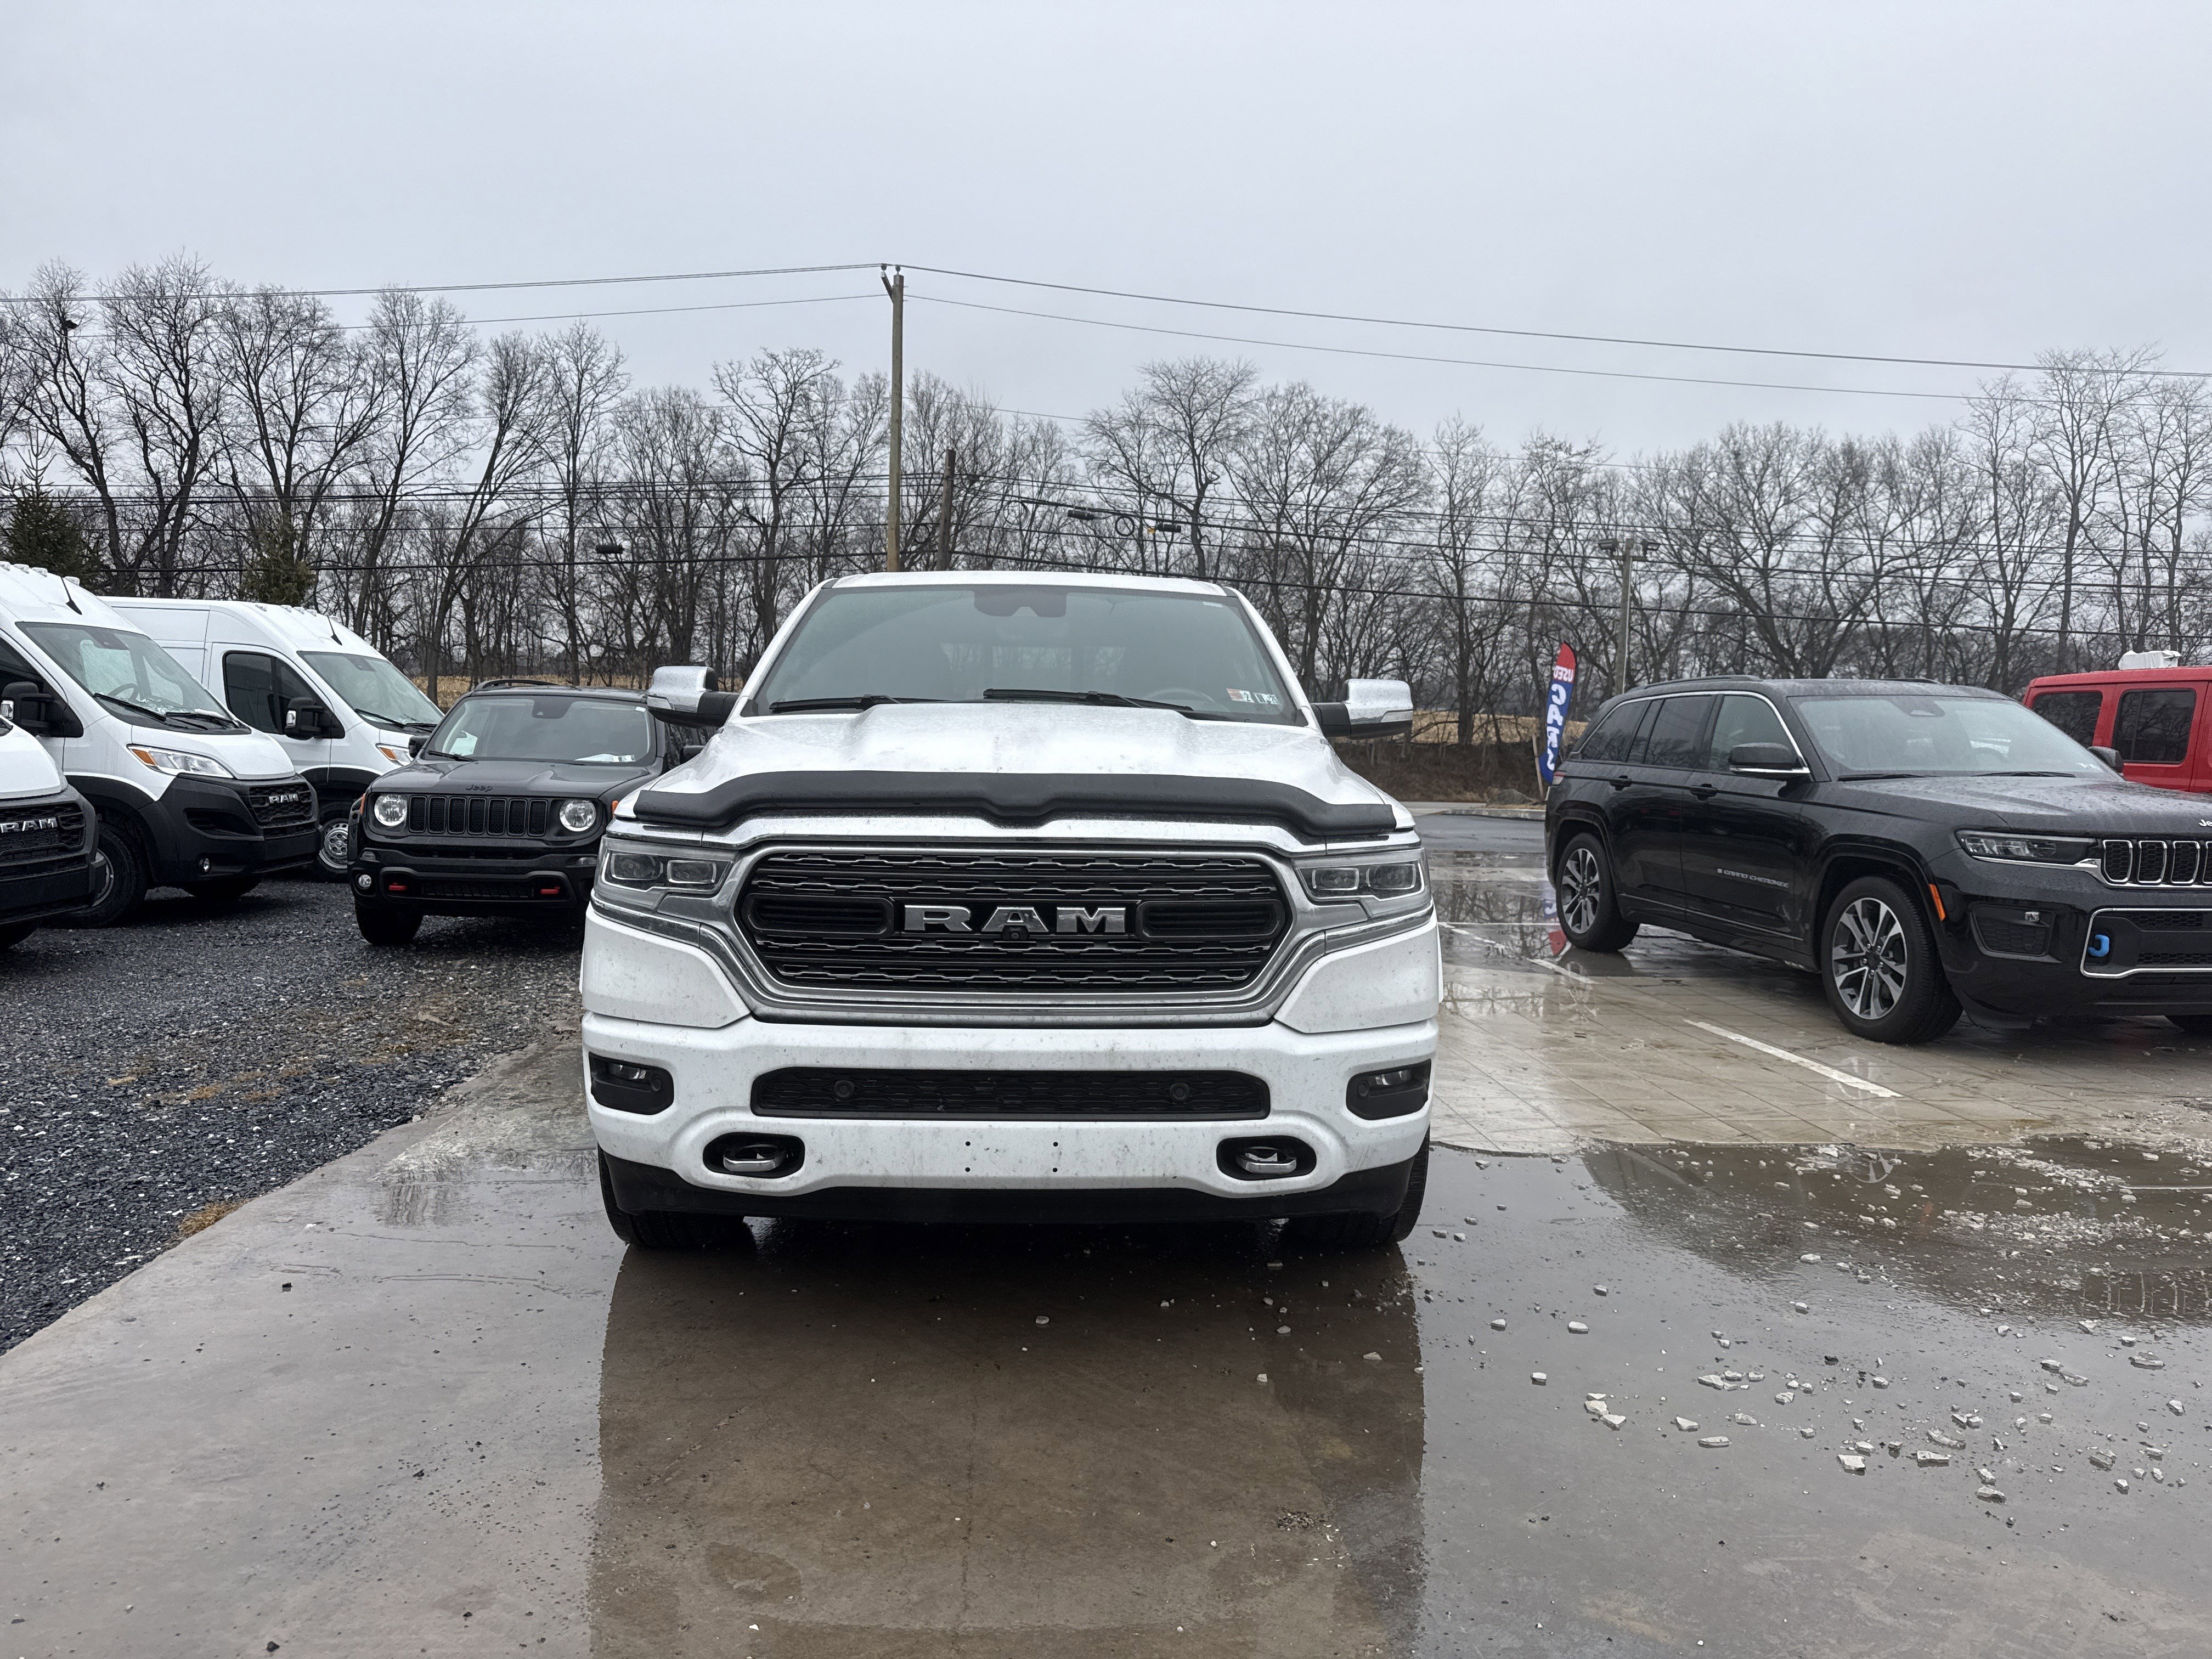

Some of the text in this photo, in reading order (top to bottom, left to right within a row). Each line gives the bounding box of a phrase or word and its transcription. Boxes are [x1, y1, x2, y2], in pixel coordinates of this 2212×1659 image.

[465, 783, 493, 792] Jeep
[269, 794, 299, 804] RAM
[0, 818, 58, 833] RAM
[904, 905, 1126, 933] RAM
